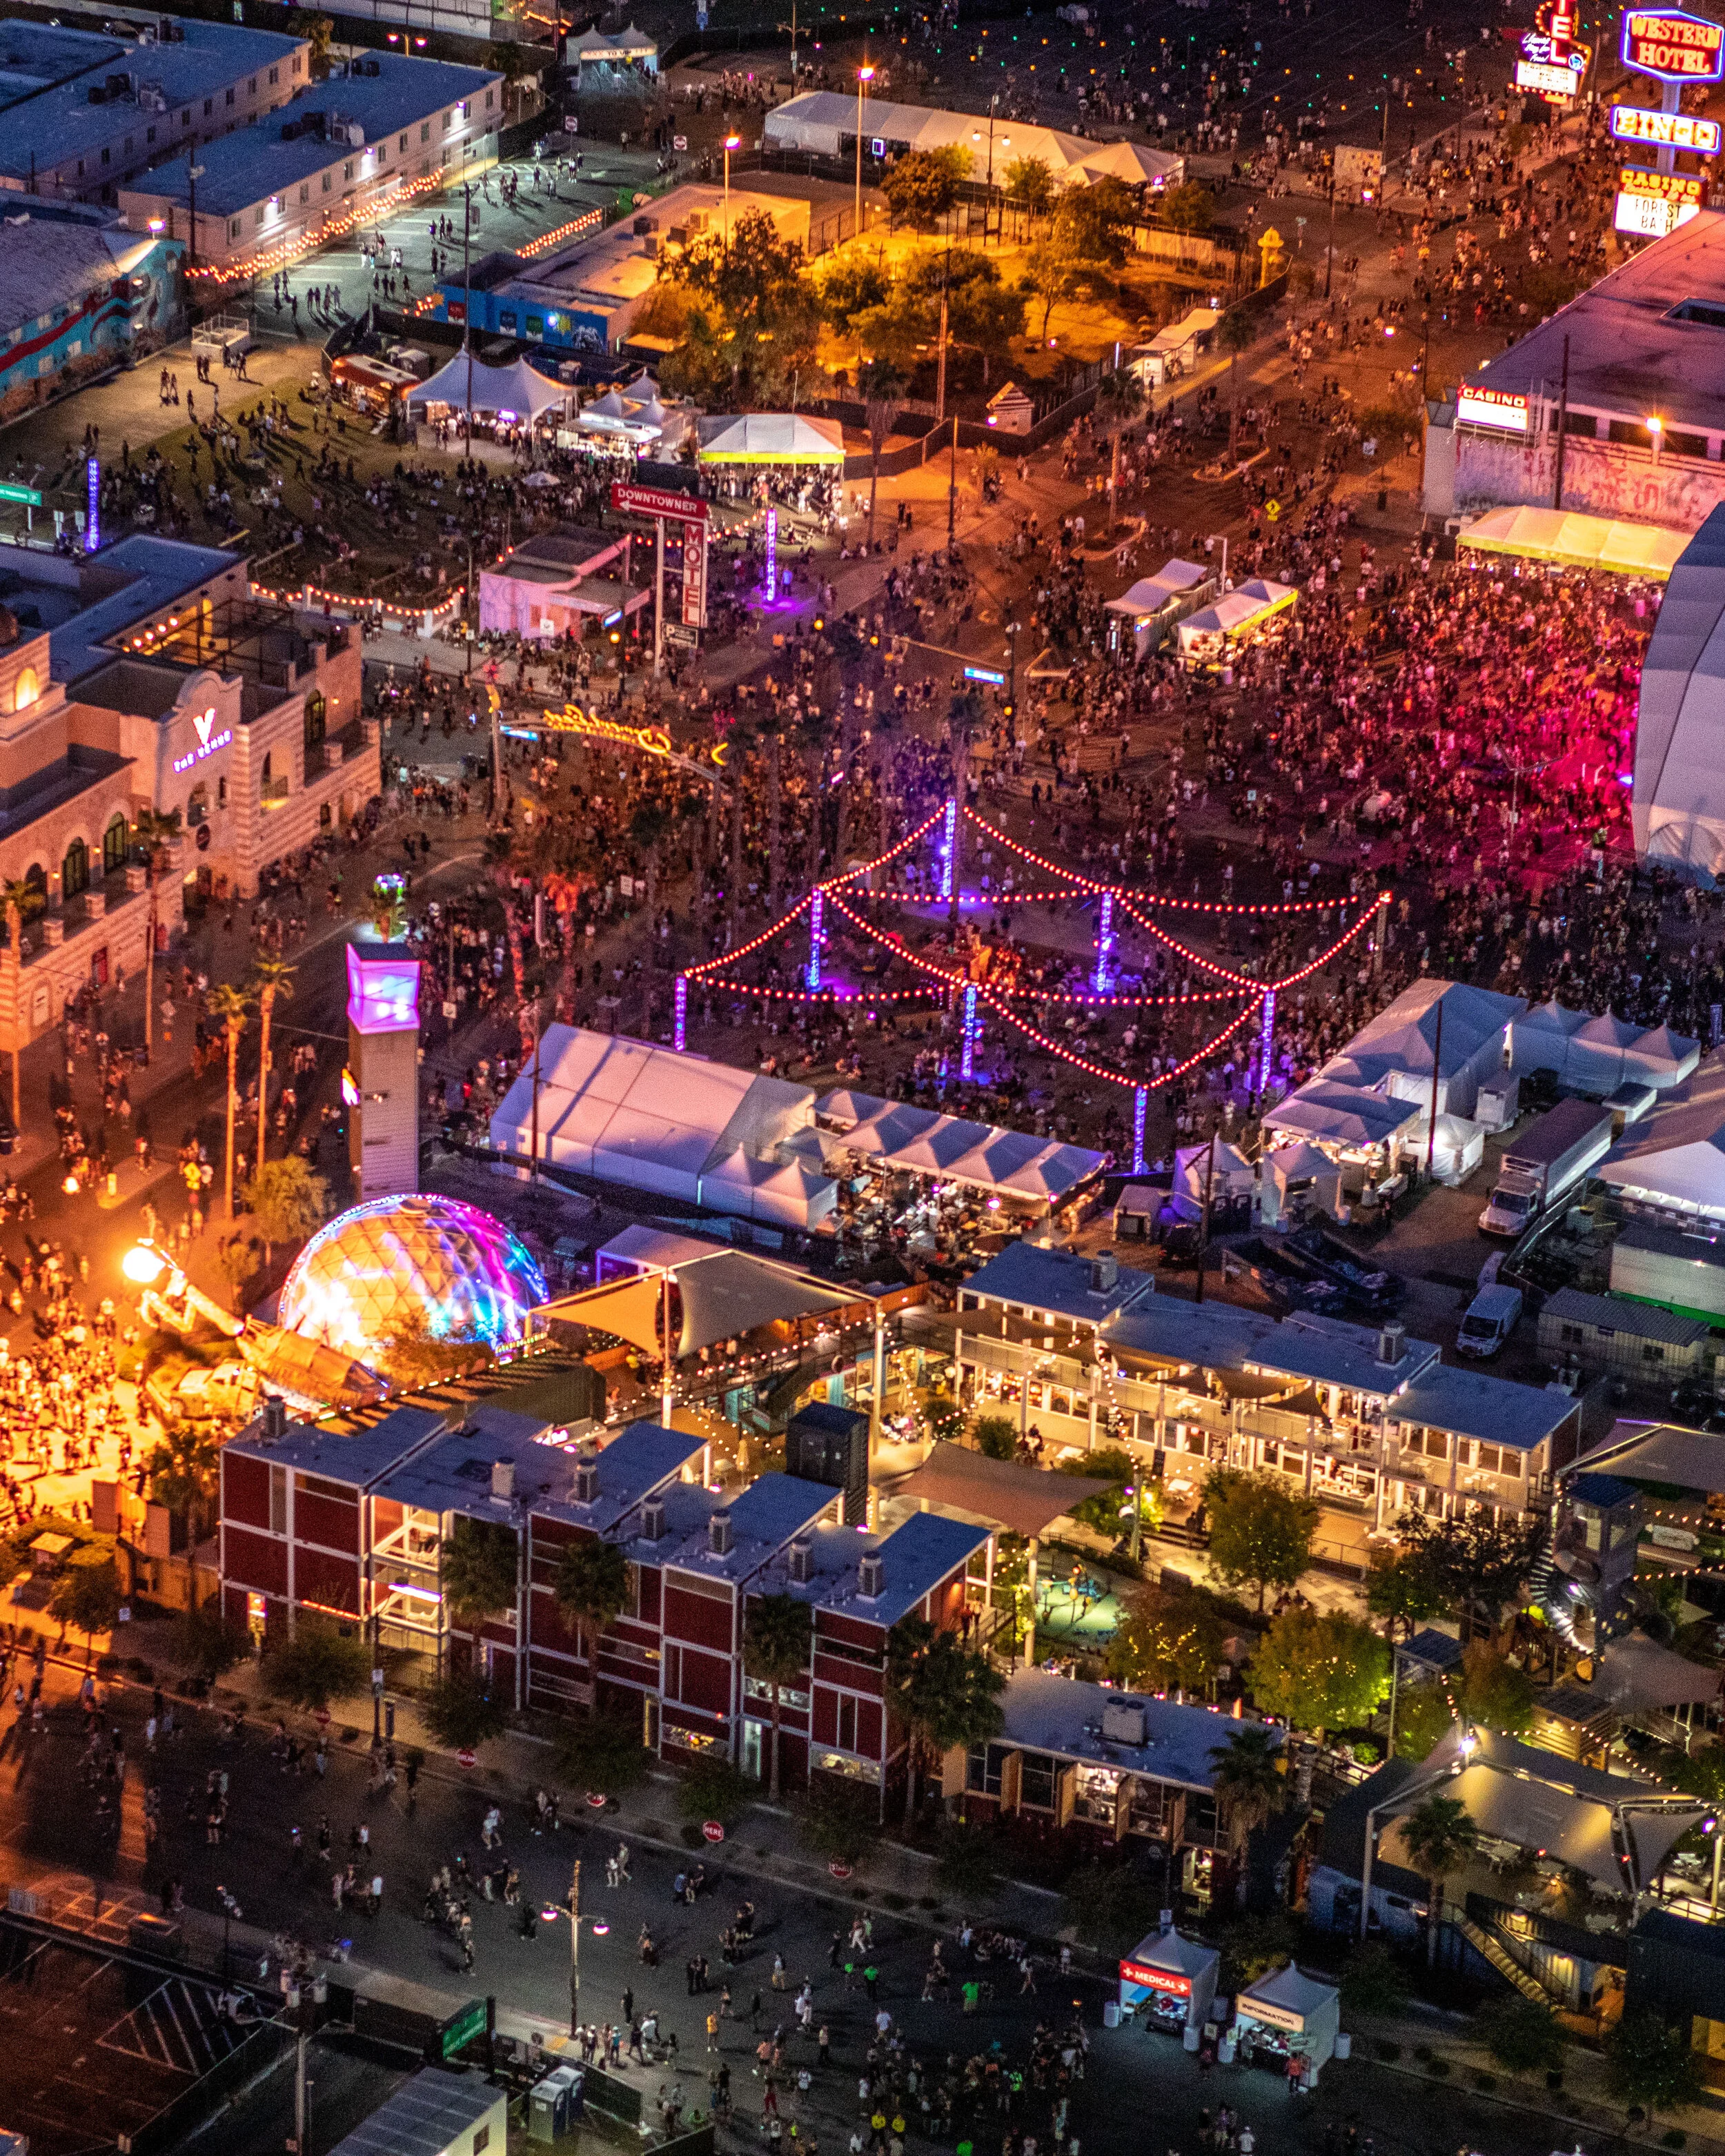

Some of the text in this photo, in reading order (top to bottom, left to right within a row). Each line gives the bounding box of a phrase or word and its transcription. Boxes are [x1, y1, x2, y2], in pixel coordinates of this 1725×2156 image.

[1630, 14, 1720, 48] WESTERN
[1637, 41, 1712, 74] HOTEL
[1617, 111, 1716, 148] BINGO
[1621, 169, 1701, 195] CASINO
[1642, 215, 1674, 233] BAH
[1463, 388, 1526, 408] CASINO
[618, 487, 697, 513] DOWNTOWNER
[684, 526, 701, 625] MOTEL
[172, 729, 233, 773] THE VENUE
[1134, 1971, 1176, 1988] MEDICAL
[1242, 2003, 1295, 2026] INFORMATION
